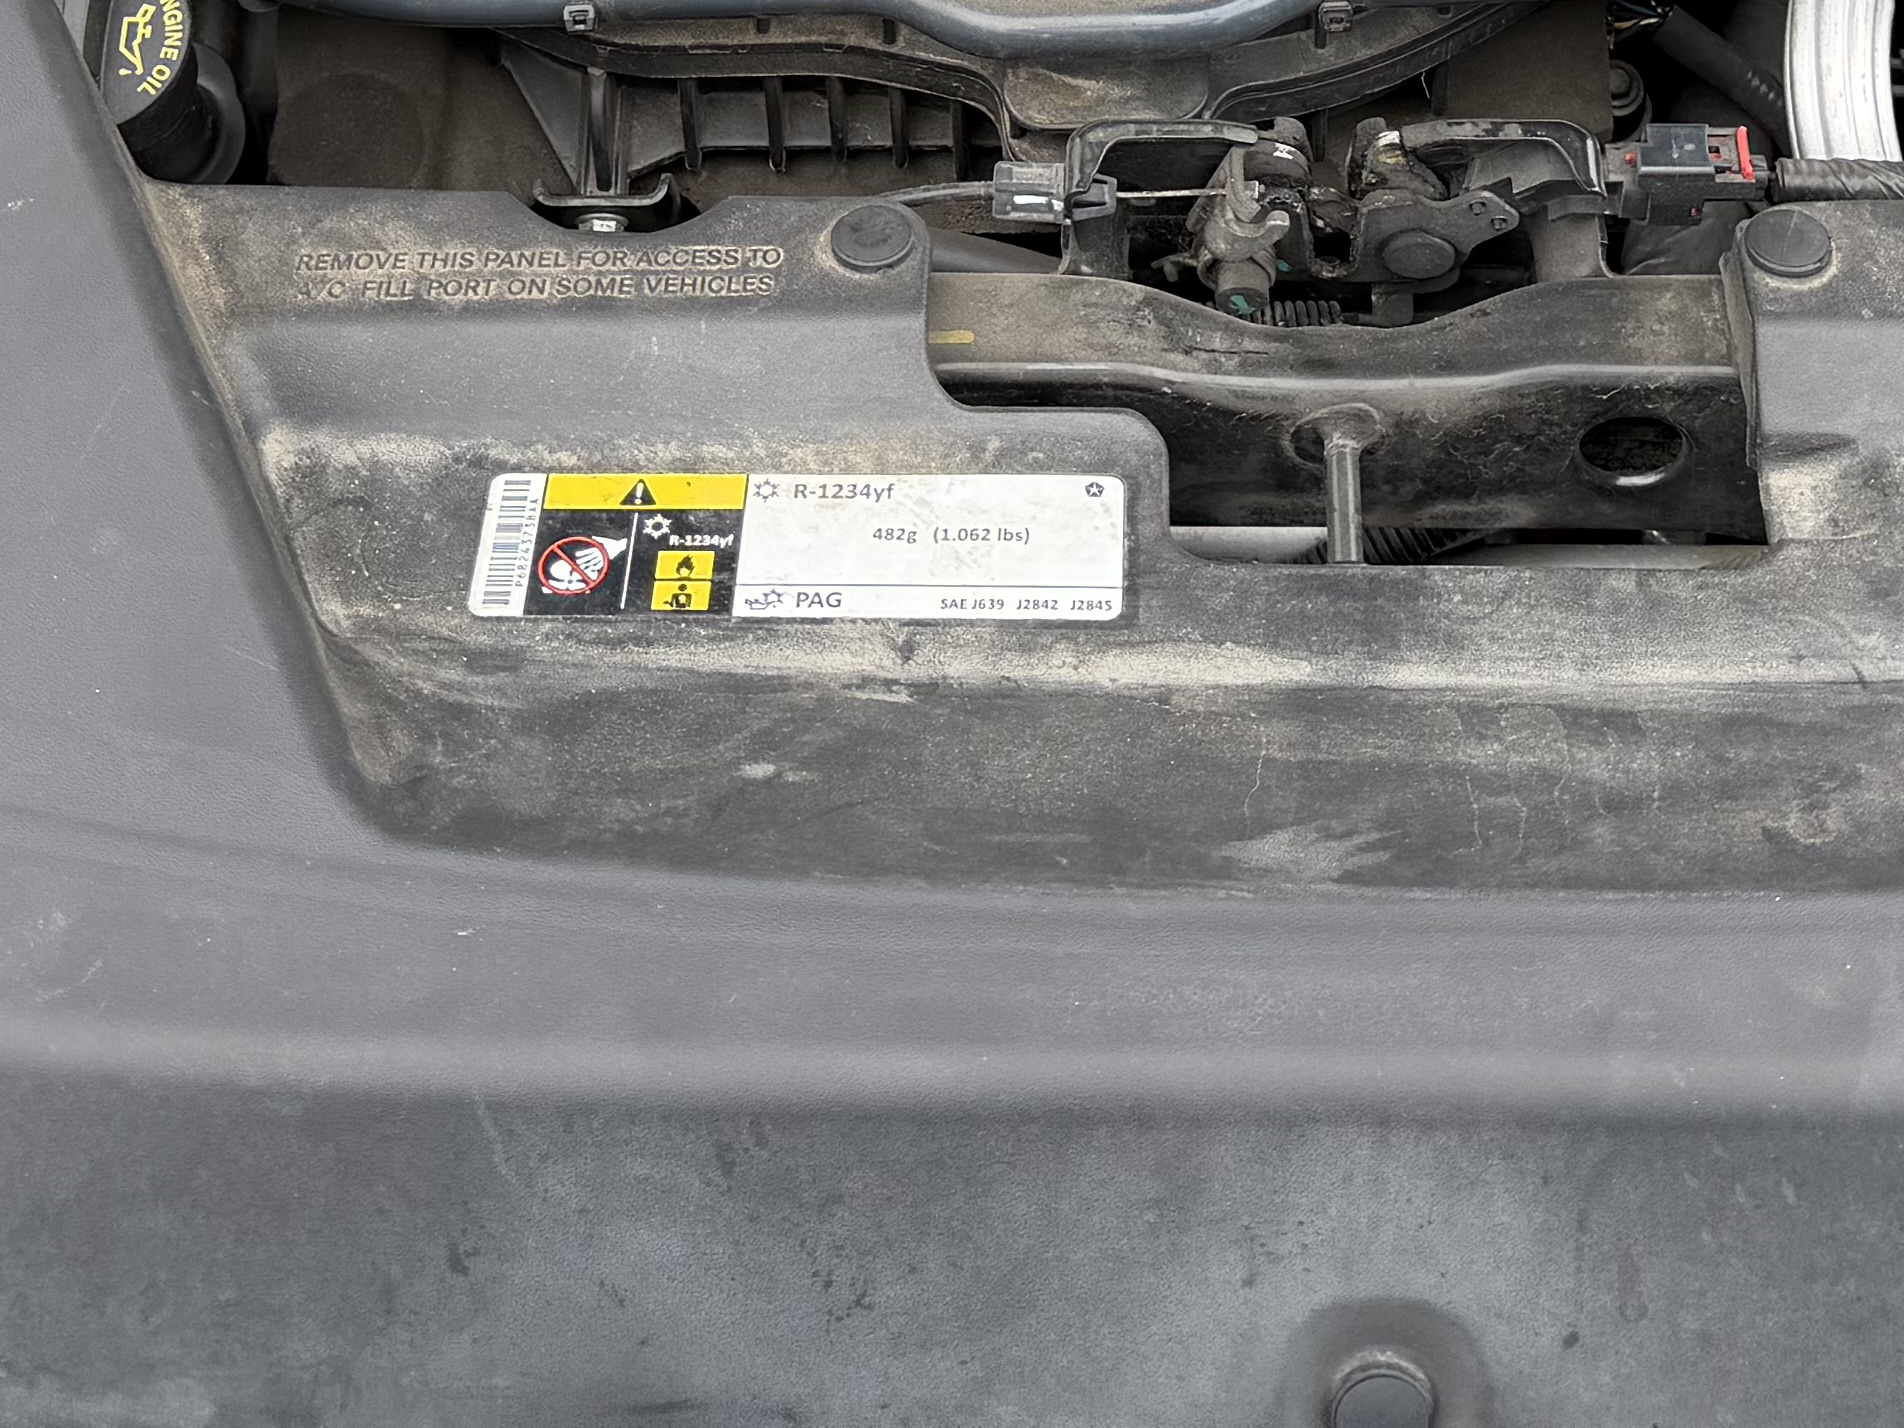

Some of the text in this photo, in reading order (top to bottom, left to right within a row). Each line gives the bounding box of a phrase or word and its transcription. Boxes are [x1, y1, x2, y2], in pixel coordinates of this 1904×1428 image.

[136, 64, 171, 95] OIL
[296, 246, 783, 272] REMOVE THIS PANEL FOR ACCESS TO
[360, 279, 413, 299] FILL
[426, 278, 499, 298] PORT
[506, 277, 547, 296] ON
[554, 275, 635, 296] SOME
[644, 274, 776, 296] VEHICLES
[793, 483, 895, 503] R-1234yf
[872, 526, 1031, 545] 482g (1.062 lbs)
[795, 591, 843, 609] PAG
[939, 598, 1113, 612] SAE J639 J2842 J2845
